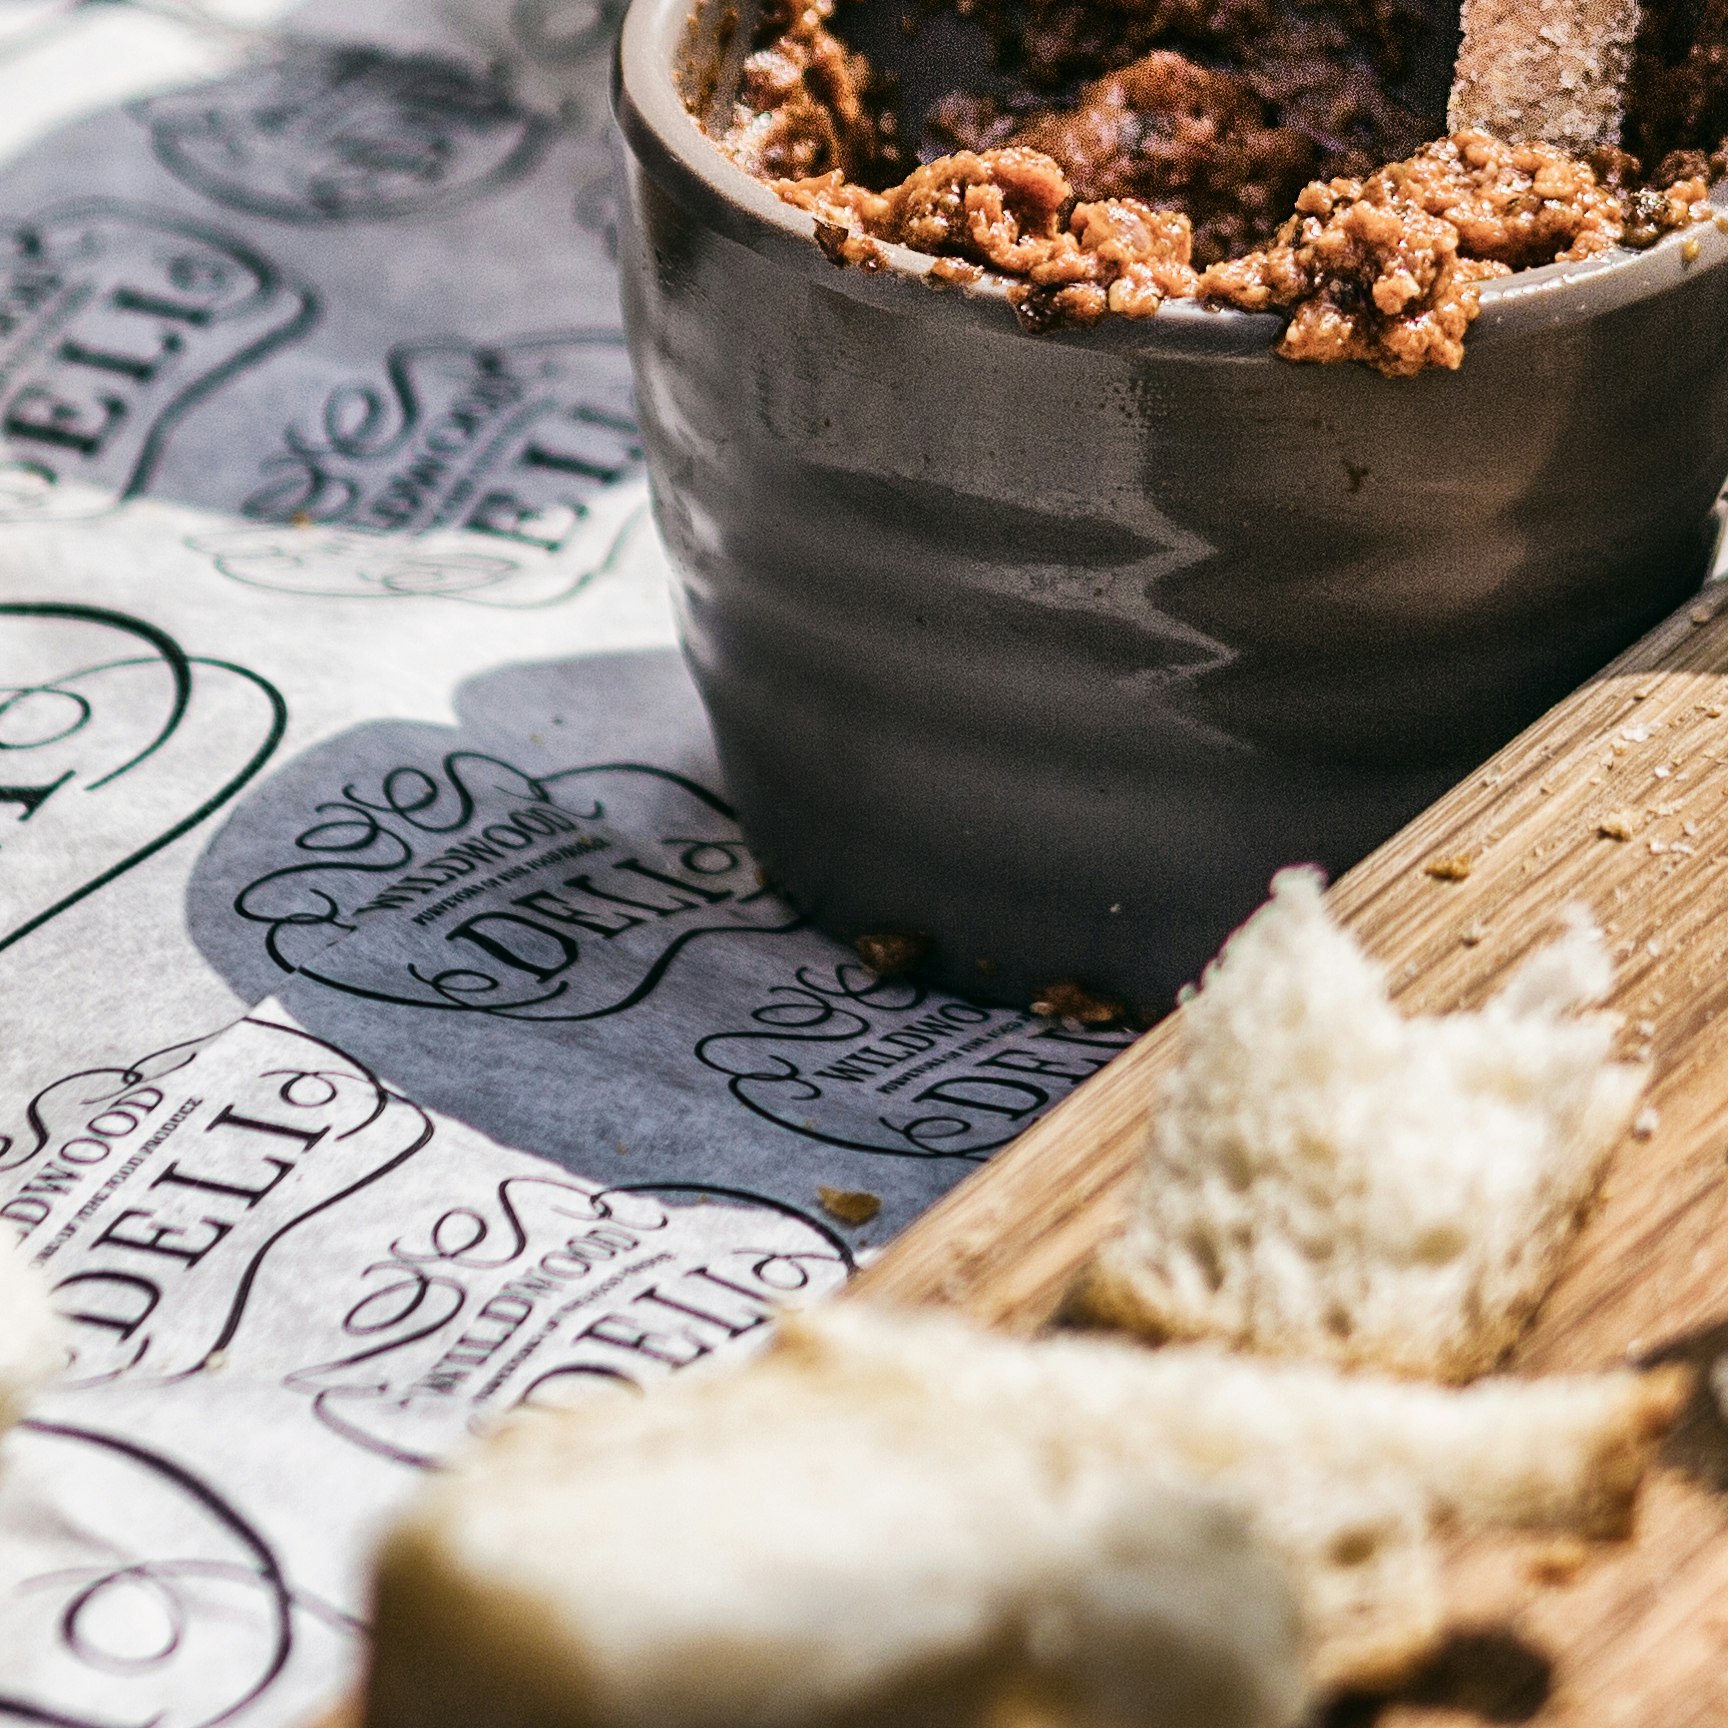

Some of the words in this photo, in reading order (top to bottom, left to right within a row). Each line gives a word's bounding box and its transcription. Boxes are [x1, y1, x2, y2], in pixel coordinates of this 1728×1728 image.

[353, 806, 577, 917] WILDWOOD
[446, 857, 734, 983] DELI
[139, 1094, 205, 1157] PRODUCE
[48, 1103, 332, 1343] DELI
